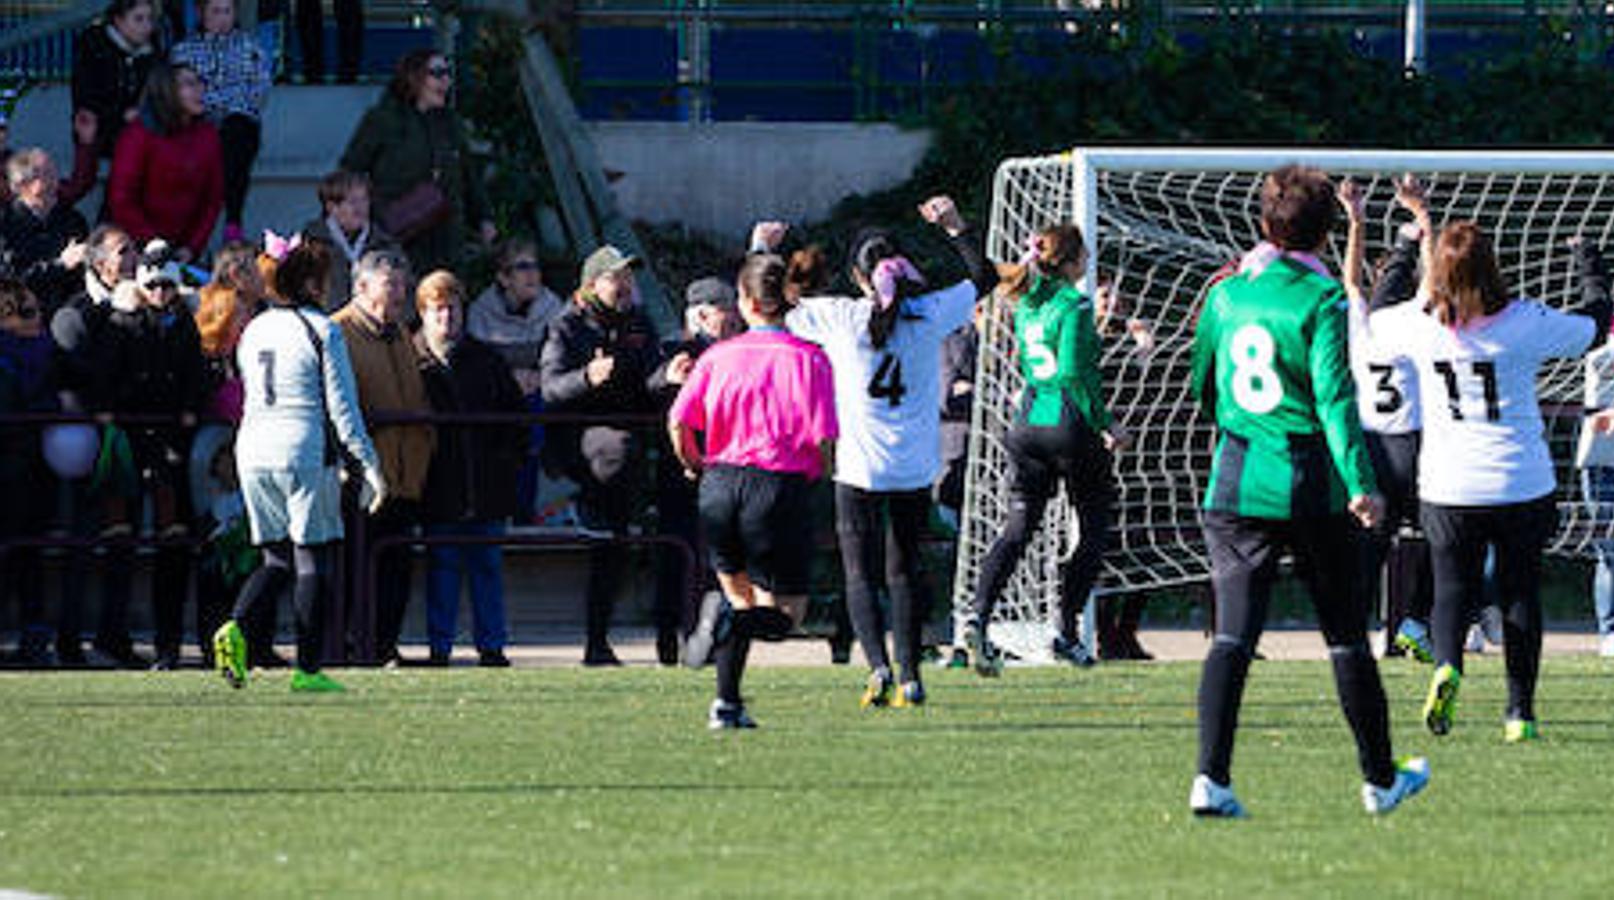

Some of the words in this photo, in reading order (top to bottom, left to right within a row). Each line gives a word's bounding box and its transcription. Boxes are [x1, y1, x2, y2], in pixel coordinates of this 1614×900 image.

[258, 350, 277, 405] 1
[1025, 324, 1056, 379] 5
[1232, 325, 1284, 413] 8
[867, 354, 906, 407] 4
[1369, 365, 1402, 413] 3
[1433, 361, 1499, 420] 11
